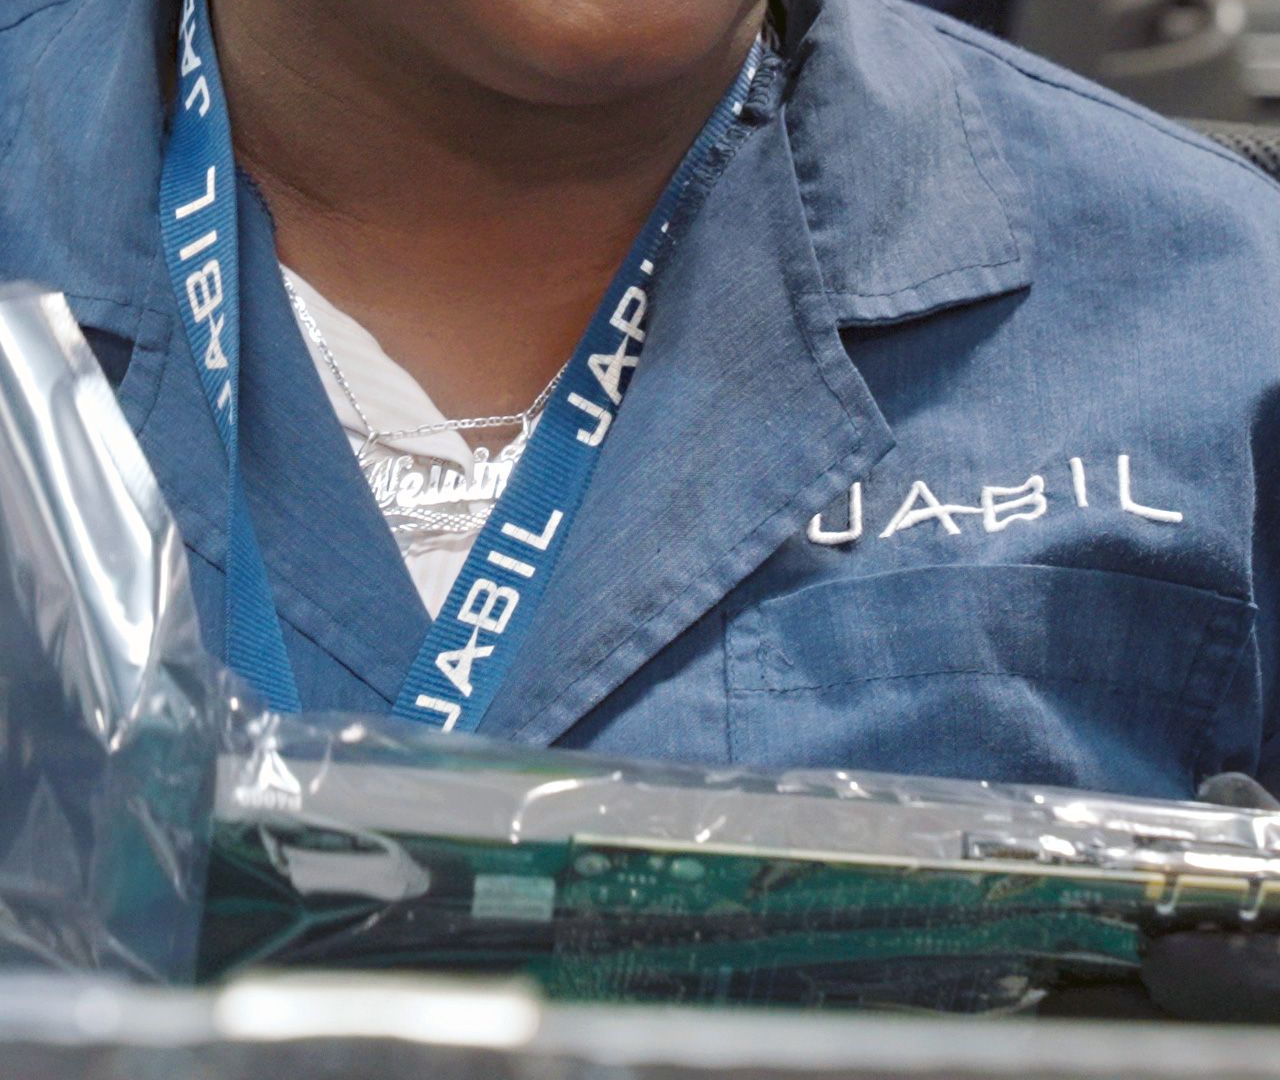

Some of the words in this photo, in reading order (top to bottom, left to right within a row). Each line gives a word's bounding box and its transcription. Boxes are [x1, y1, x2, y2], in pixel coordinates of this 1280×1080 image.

[567, 222, 670, 447] JAB
[807, 453, 1183, 545] JABIL
[415, 509, 564, 734] JABIL
